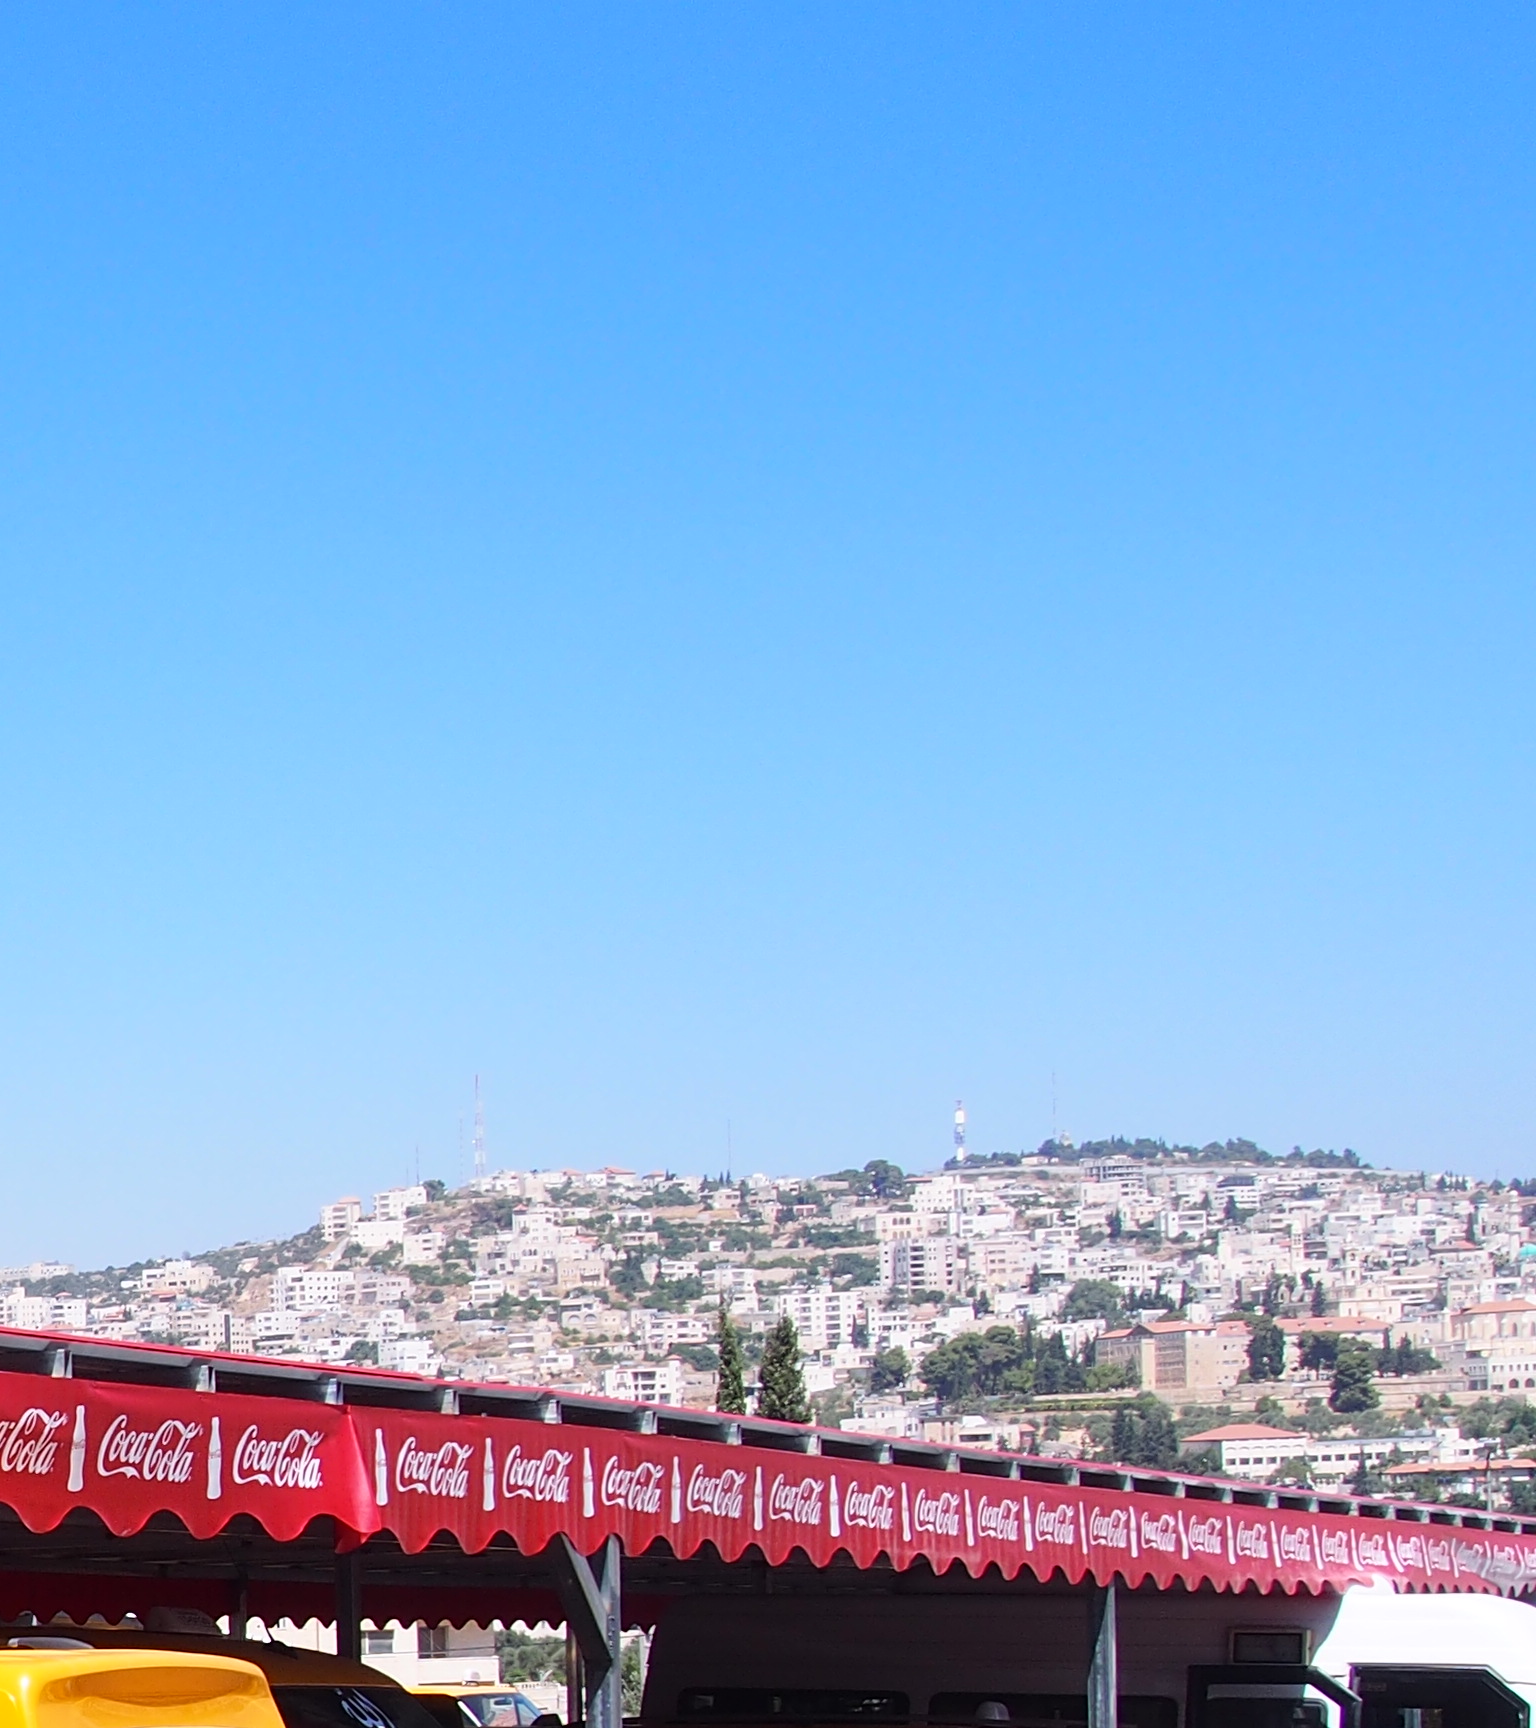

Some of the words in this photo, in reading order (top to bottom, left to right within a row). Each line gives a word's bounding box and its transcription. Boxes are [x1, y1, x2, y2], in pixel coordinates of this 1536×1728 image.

[97, 1414, 203, 1484] Coca-Cola
[232, 1424, 324, 1489] Coca-Cola
[395, 1436, 474, 1499] Coca-Cola
[502, 1444, 574, 1504] Coca-Cola
[601, 1455, 665, 1514] Coca-Cola
[687, 1463, 747, 1519] Coca-Cola
[769, 1472, 824, 1526] Coca-Cola
[845, 1481, 895, 1530] Coca-Cola
[914, 1488, 960, 1537] Coca-Cola
[977, 1494, 1019, 1543] Coca-Cola
